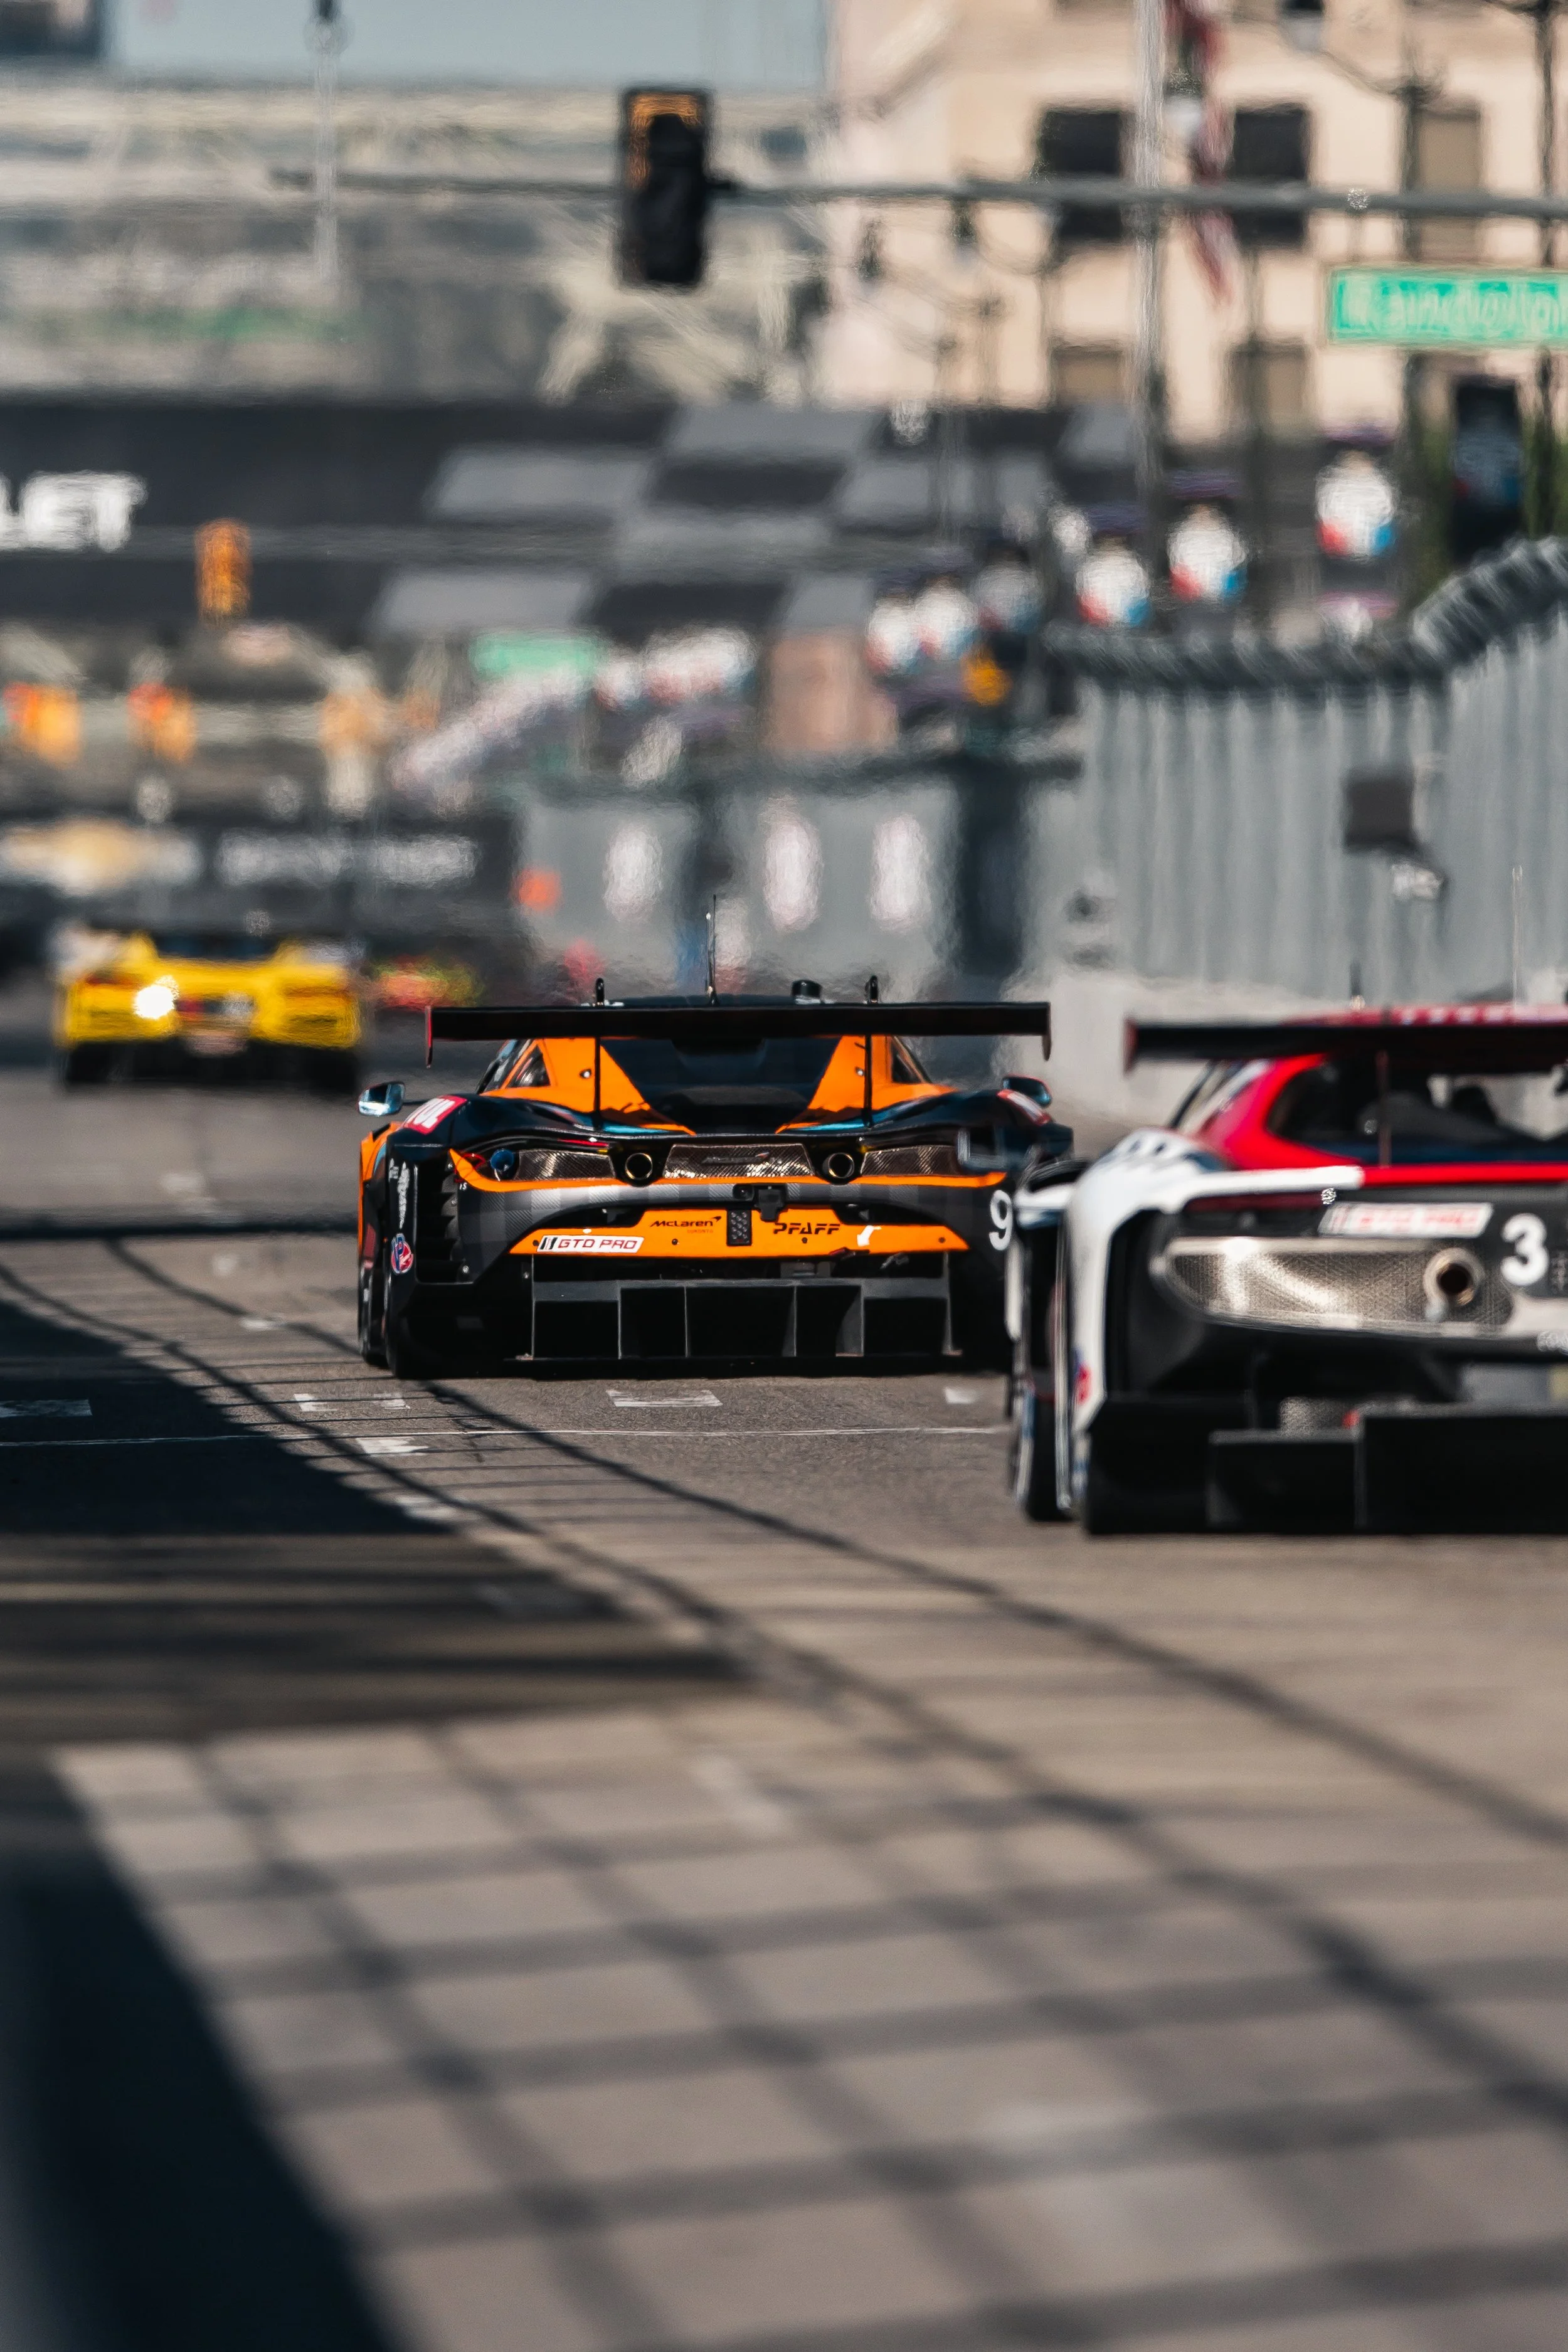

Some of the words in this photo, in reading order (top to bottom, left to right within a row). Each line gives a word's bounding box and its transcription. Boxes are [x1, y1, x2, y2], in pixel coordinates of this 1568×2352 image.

[773, 1222, 840, 1235] PFAFF
[989, 1190, 1013, 1251] 9
[558, 1239, 595, 1248] GTD
[599, 1239, 638, 1249] PRO
[1501, 1213, 1549, 1286] 3
